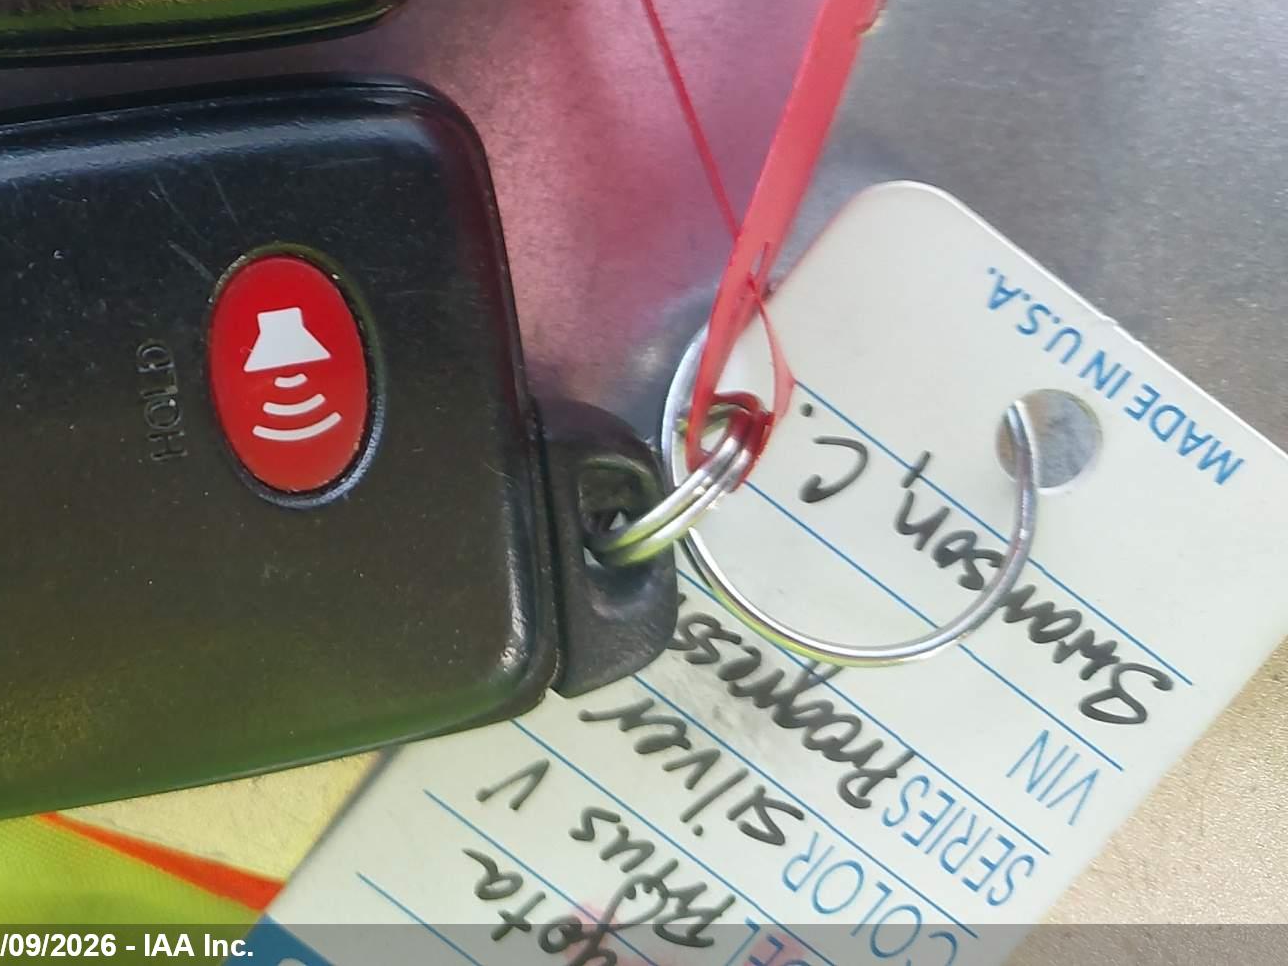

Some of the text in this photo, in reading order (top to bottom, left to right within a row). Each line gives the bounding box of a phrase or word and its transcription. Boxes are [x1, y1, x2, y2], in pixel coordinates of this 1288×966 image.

[136, 338, 188, 461] HOLD
[987, 267, 1244, 485] MADE IN U.S.A.
[798, 402, 869, 503] C.
[1006, 730, 1100, 826] VIN
[881, 775, 1036, 906] SERIES
